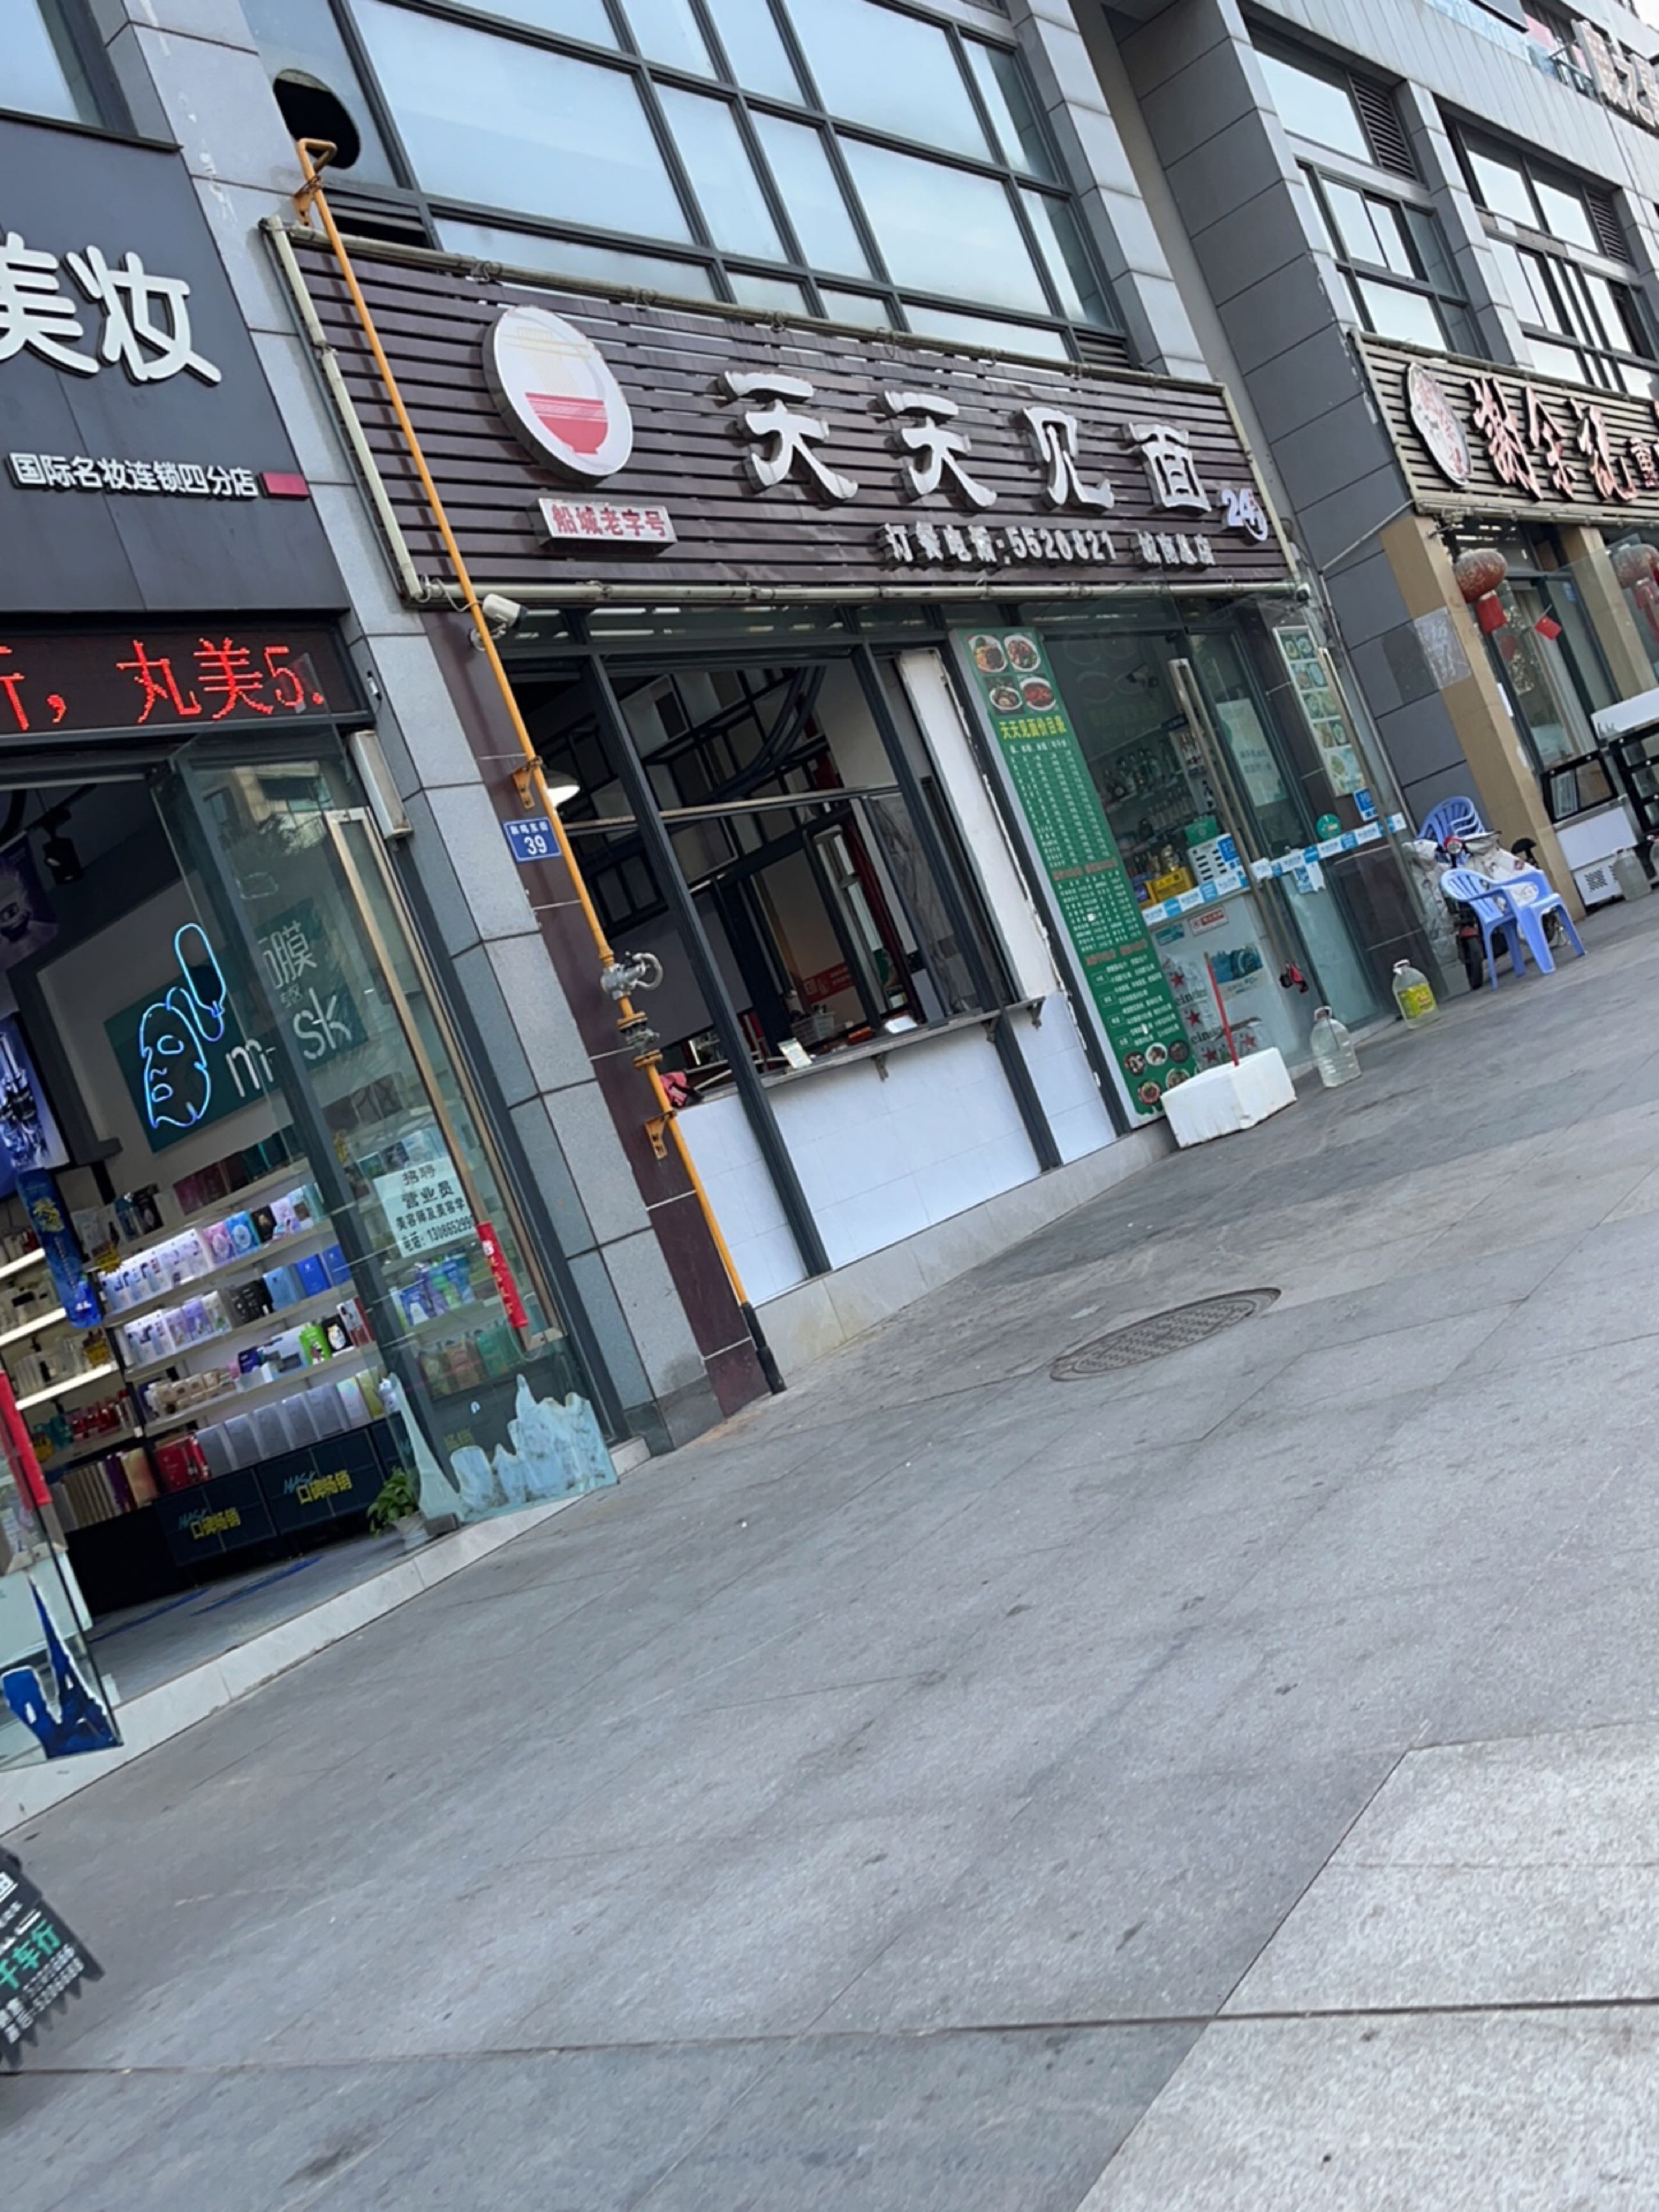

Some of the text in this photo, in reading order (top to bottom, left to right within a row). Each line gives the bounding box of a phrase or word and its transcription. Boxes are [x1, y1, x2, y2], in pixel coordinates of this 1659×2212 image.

[9, 452, 259, 497] 国际名妆连锁四分店
[524, 834, 548, 855] 39
